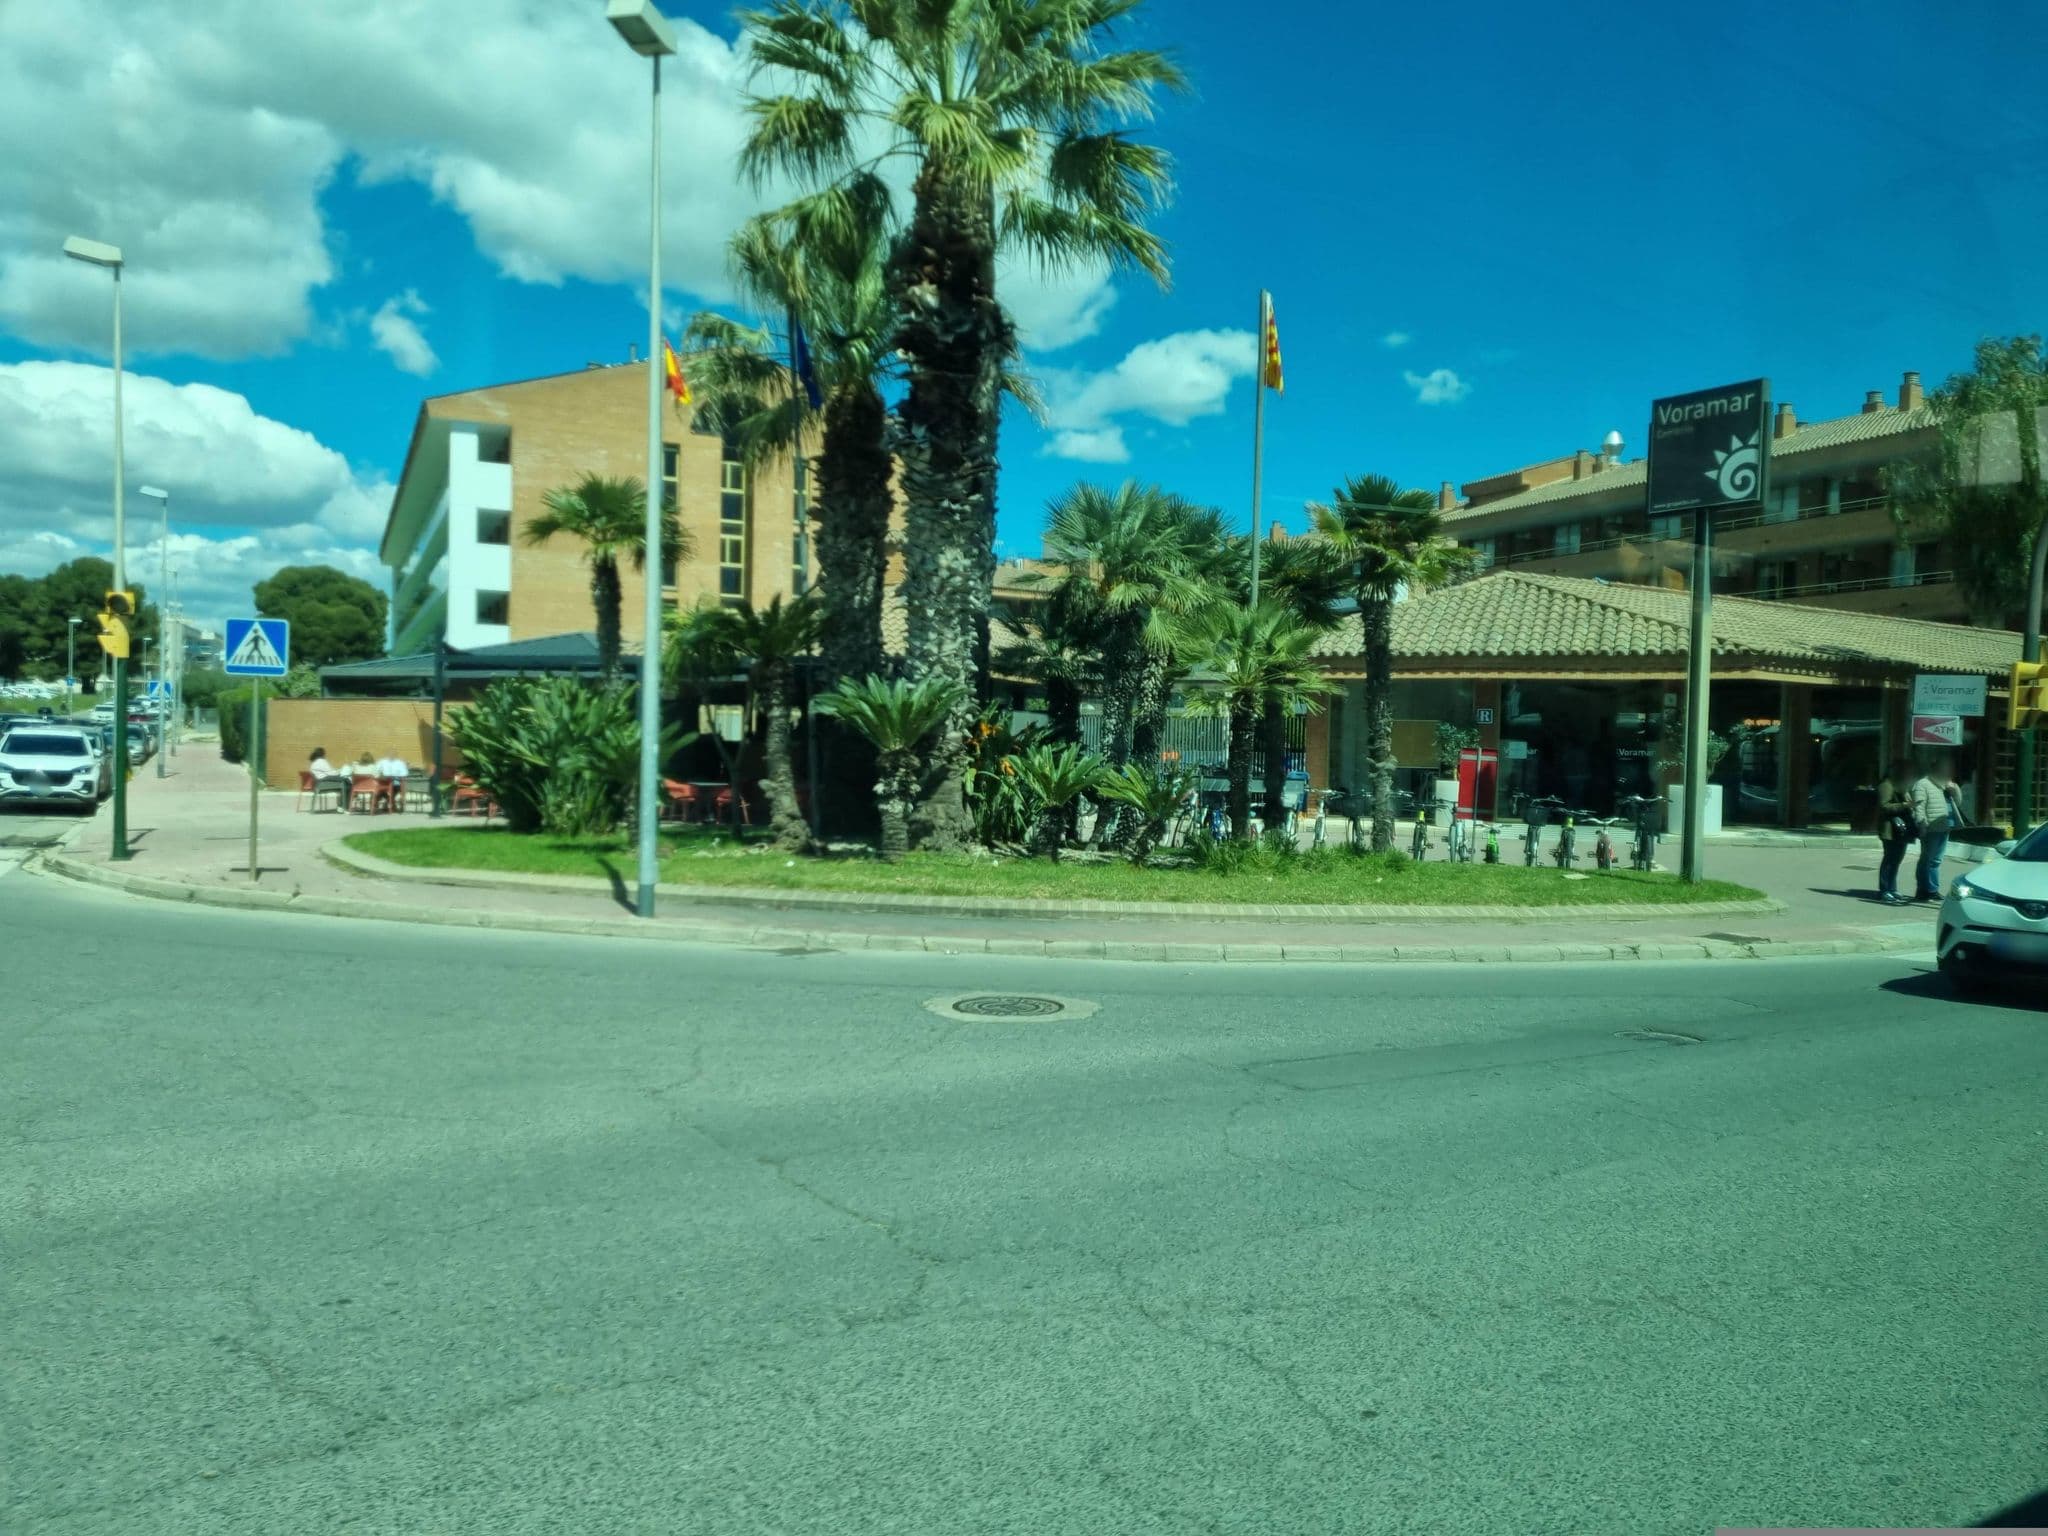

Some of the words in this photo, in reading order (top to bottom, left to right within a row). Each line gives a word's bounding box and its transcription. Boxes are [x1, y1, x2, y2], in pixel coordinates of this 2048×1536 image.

[1658, 393, 1755, 425] Voramar
[1931, 685, 1977, 695] Voramar
[1480, 710, 1490, 722] R
[1934, 727, 1954, 735] ATM
[1618, 748, 1656, 757] Voramar
